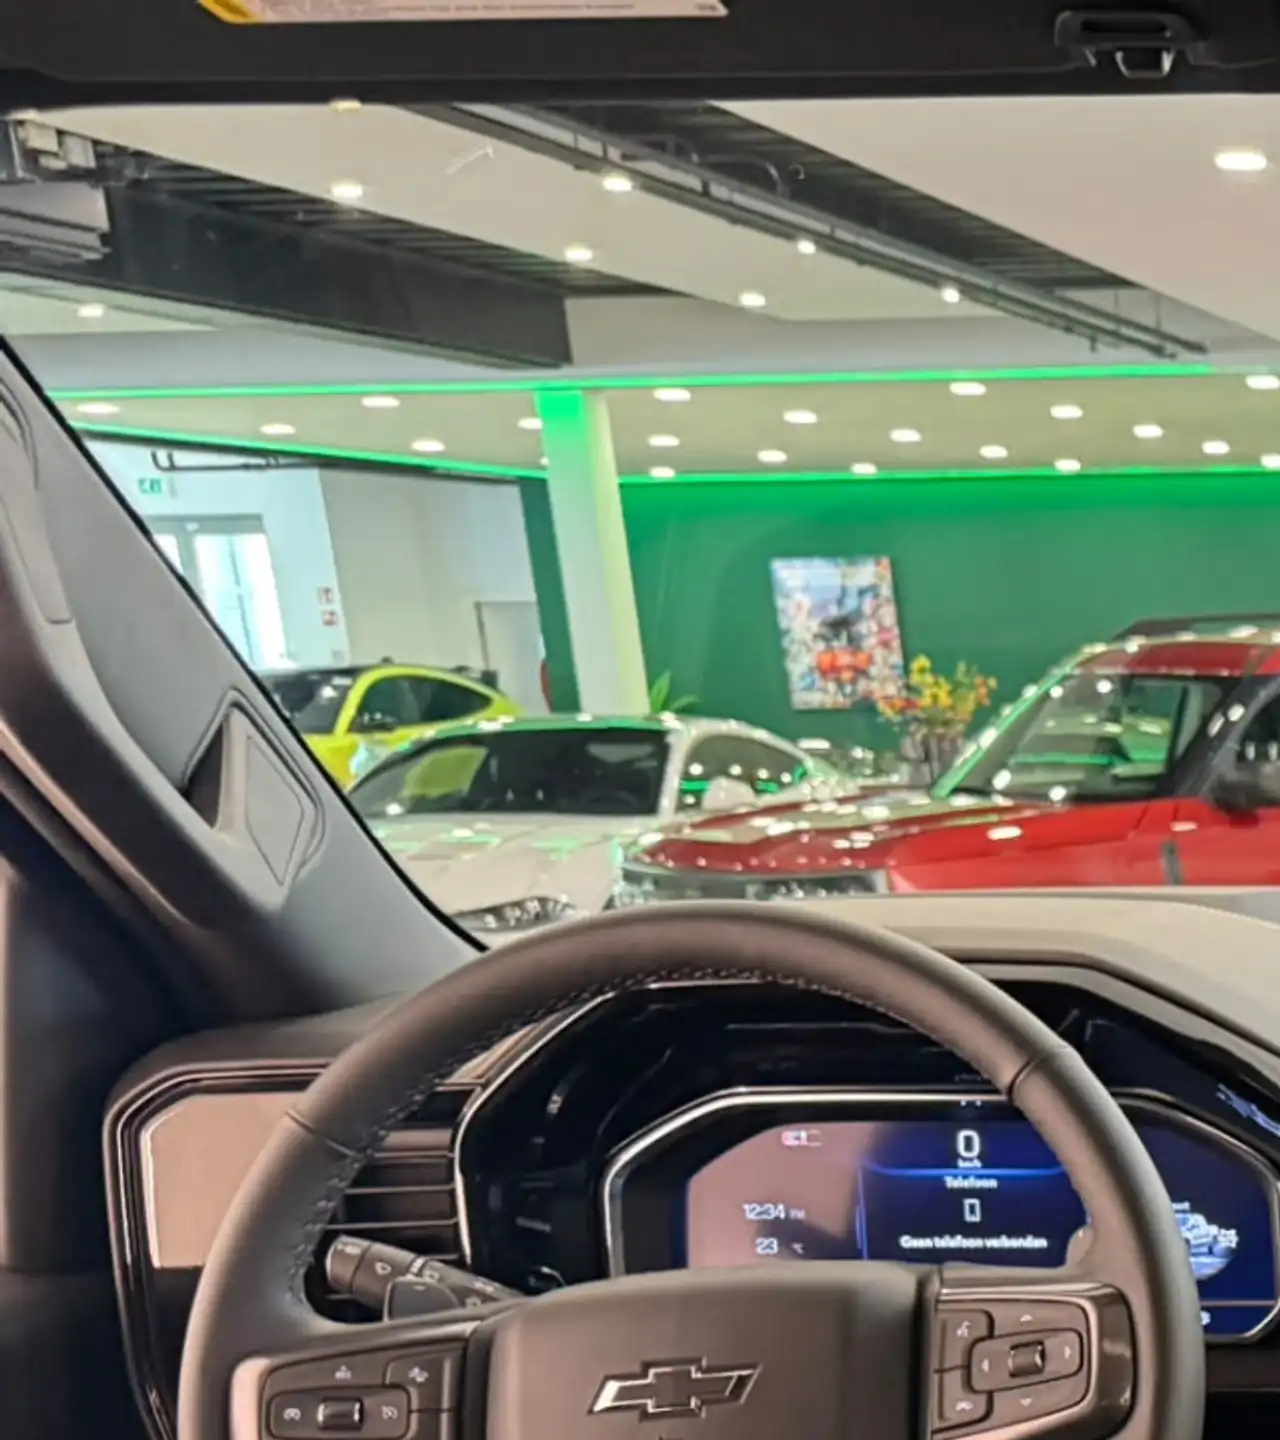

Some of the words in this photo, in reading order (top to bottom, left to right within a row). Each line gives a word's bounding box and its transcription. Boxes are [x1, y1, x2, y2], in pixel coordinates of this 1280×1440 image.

[957, 1130, 980, 1158] 0
[945, 1176, 997, 1188] Telefoon
[934, 1235, 983, 1248] telefoon
[985, 1235, 1048, 1248] verbonden
